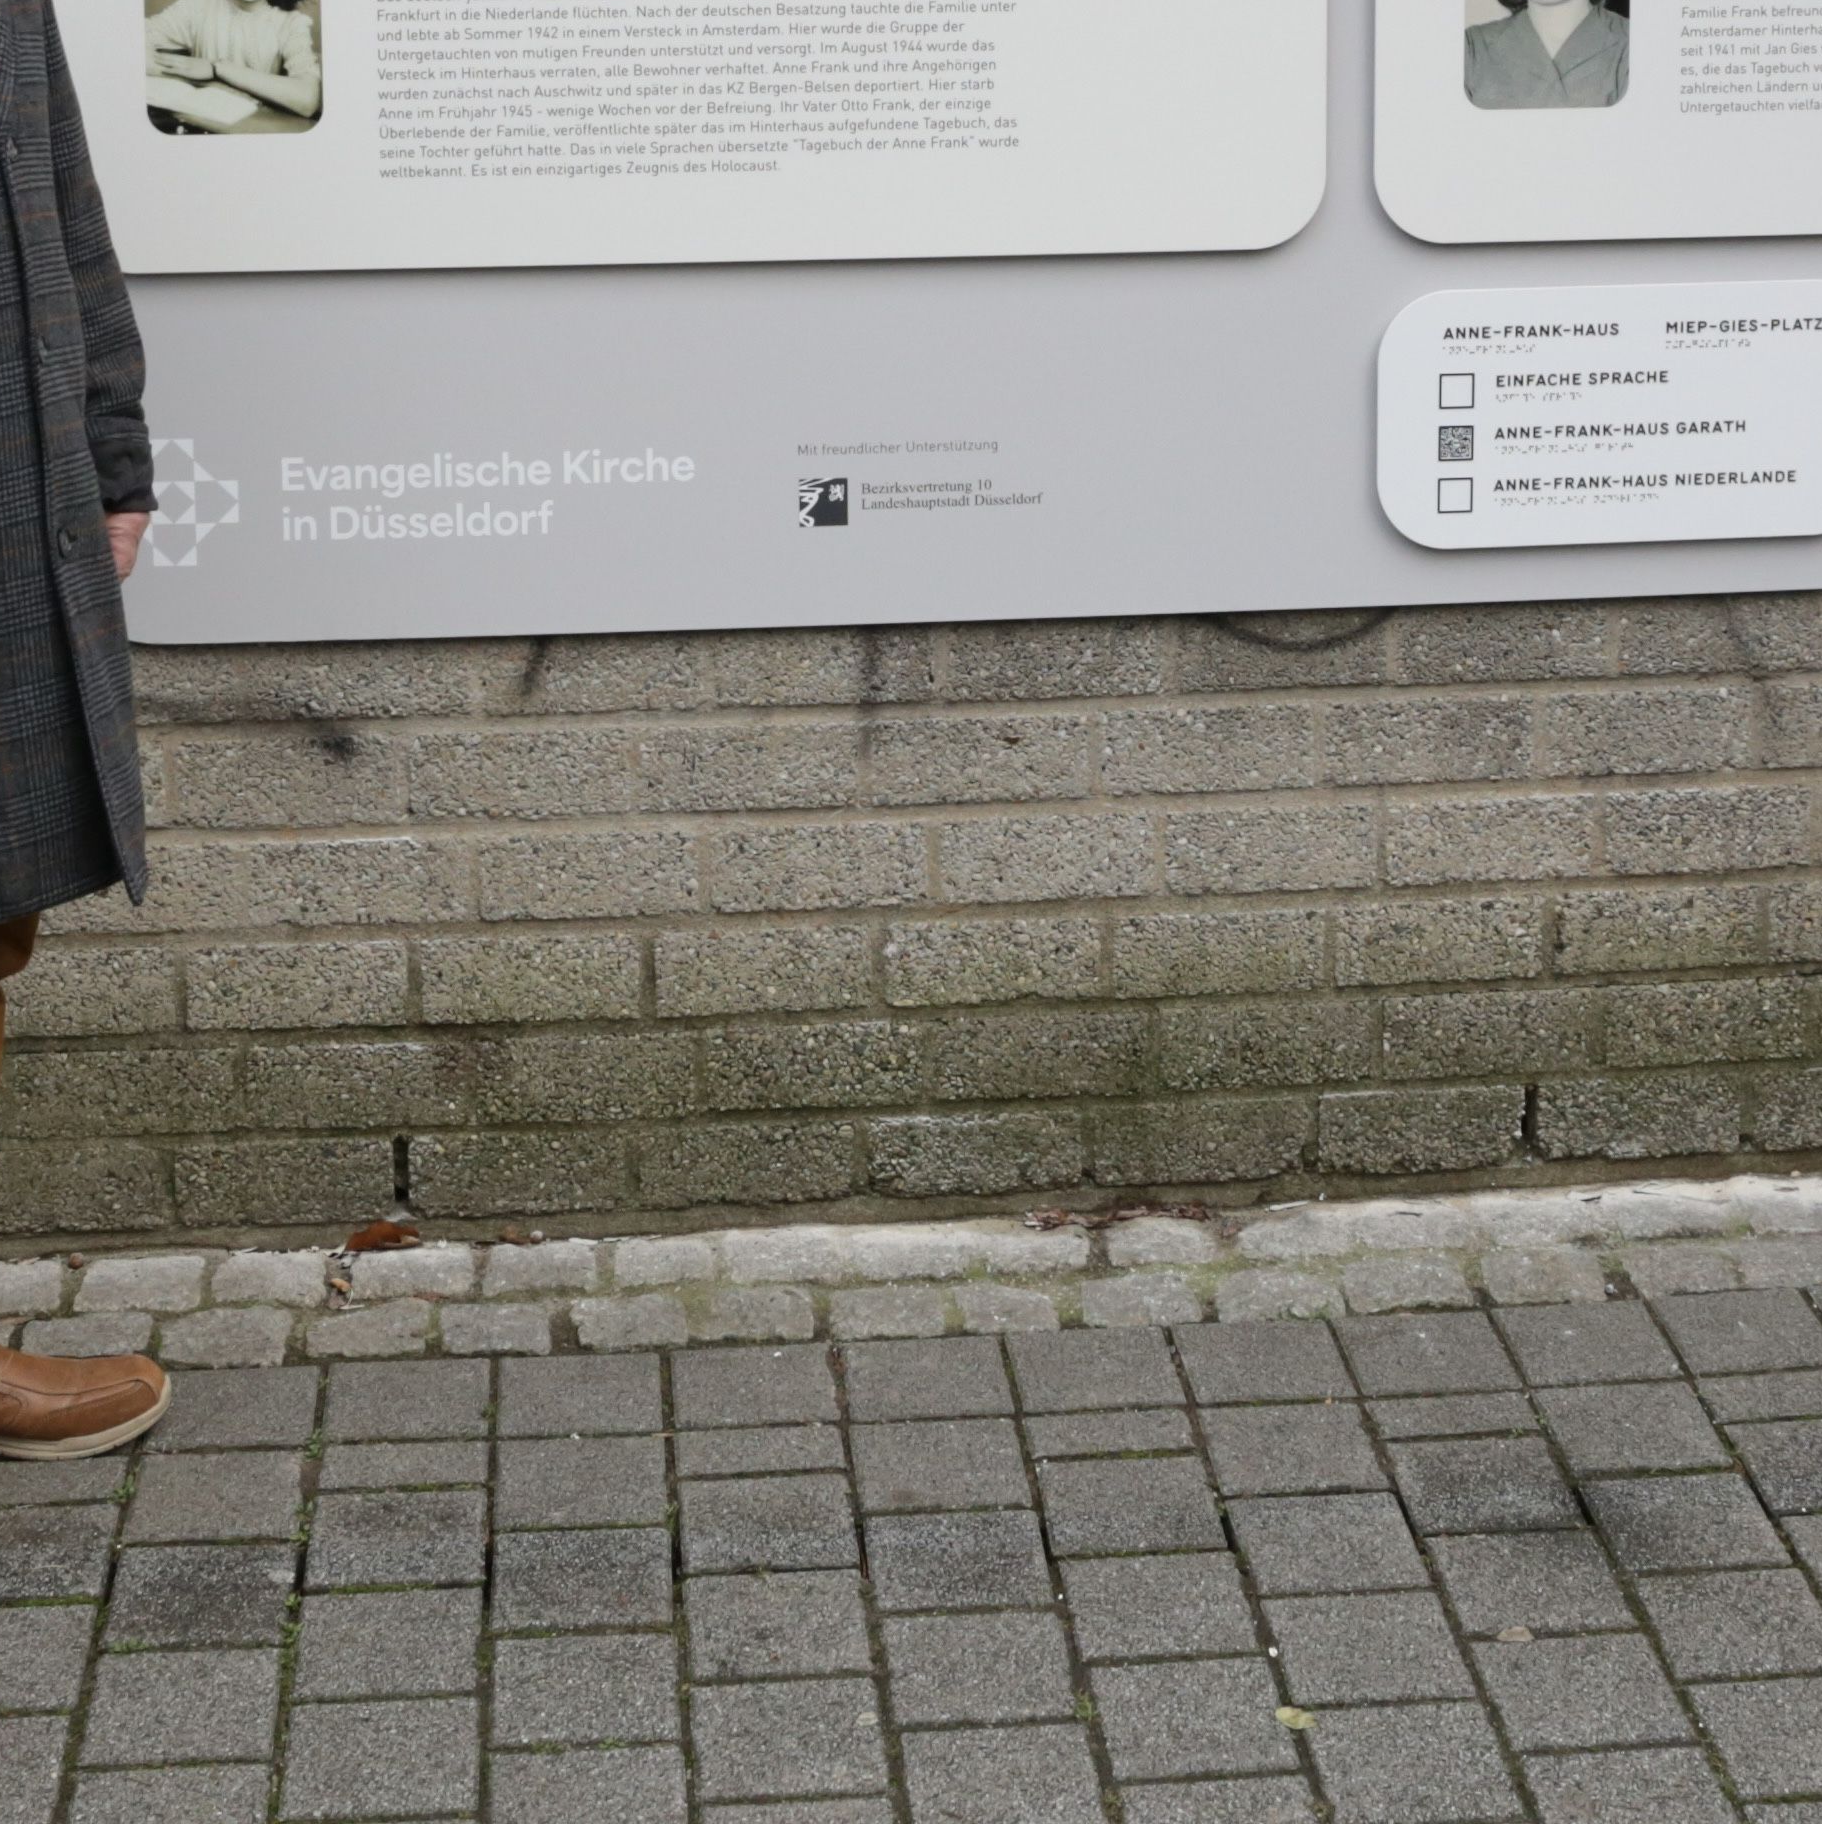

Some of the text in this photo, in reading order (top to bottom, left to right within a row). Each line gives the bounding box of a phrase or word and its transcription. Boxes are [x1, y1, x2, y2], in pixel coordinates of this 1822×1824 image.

[376, 0, 1017, 22] Frankfurt in die Niederlande flüchten. Nach der deutschen Besatzung tauchte die Familie unter
[376, 19, 966, 42] und lebte ab Sommer 1942 in einem Versteck in Amsterdam. Hier wurde die Gruppe der
[376, 39, 996, 64] Untergetauchten von mutigen Freunden unterstützt und versorgt. Im August 1944 wurde das
[376, 58, 997, 81] Versteck im Hinterhaus verraten, alle Bewohner verhaftet. Anne Frank und ihre Angehörigen
[378, 159, 780, 178] weltbekannt. Es ist ein einzigartiges Zeugnis des Holocaust.
[1442, 323, 1619, 339] ANNE-FRANK-HAUS
[1495, 370, 1668, 388] EINFACHE SPRACHE
[1493, 419, 1746, 439] ANNE-FRANK-HAUS GARATH
[796, 439, 1002, 457] Mit freundlicher Unterstützung
[280, 448, 696, 497] Evangelische Kirche
[1492, 469, 1796, 491] ANNE-FRANK-HAUS NIEDERLANDE
[861, 479, 992, 495] Bezirksvertretung 10
[861, 492, 1044, 510] Landeshauptstadt Düsseldorf
[281, 500, 554, 541] in Düsseldorf
